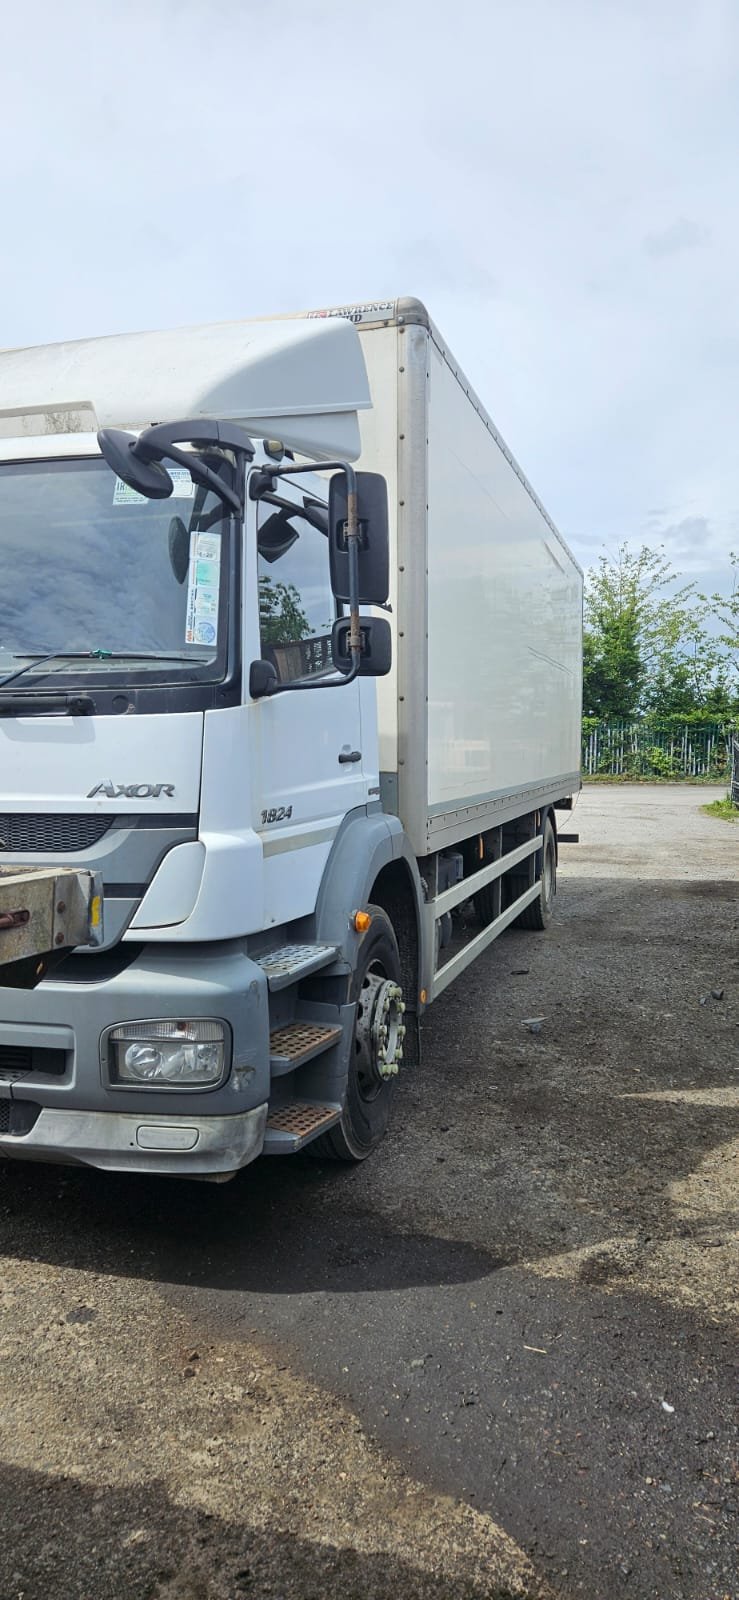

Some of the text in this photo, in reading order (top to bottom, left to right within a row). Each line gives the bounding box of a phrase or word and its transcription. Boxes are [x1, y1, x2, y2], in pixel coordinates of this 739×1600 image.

[328, 302, 393, 317] LAWRENCE
[86, 779, 175, 798] AXOR
[261, 805, 292, 824] 1824
